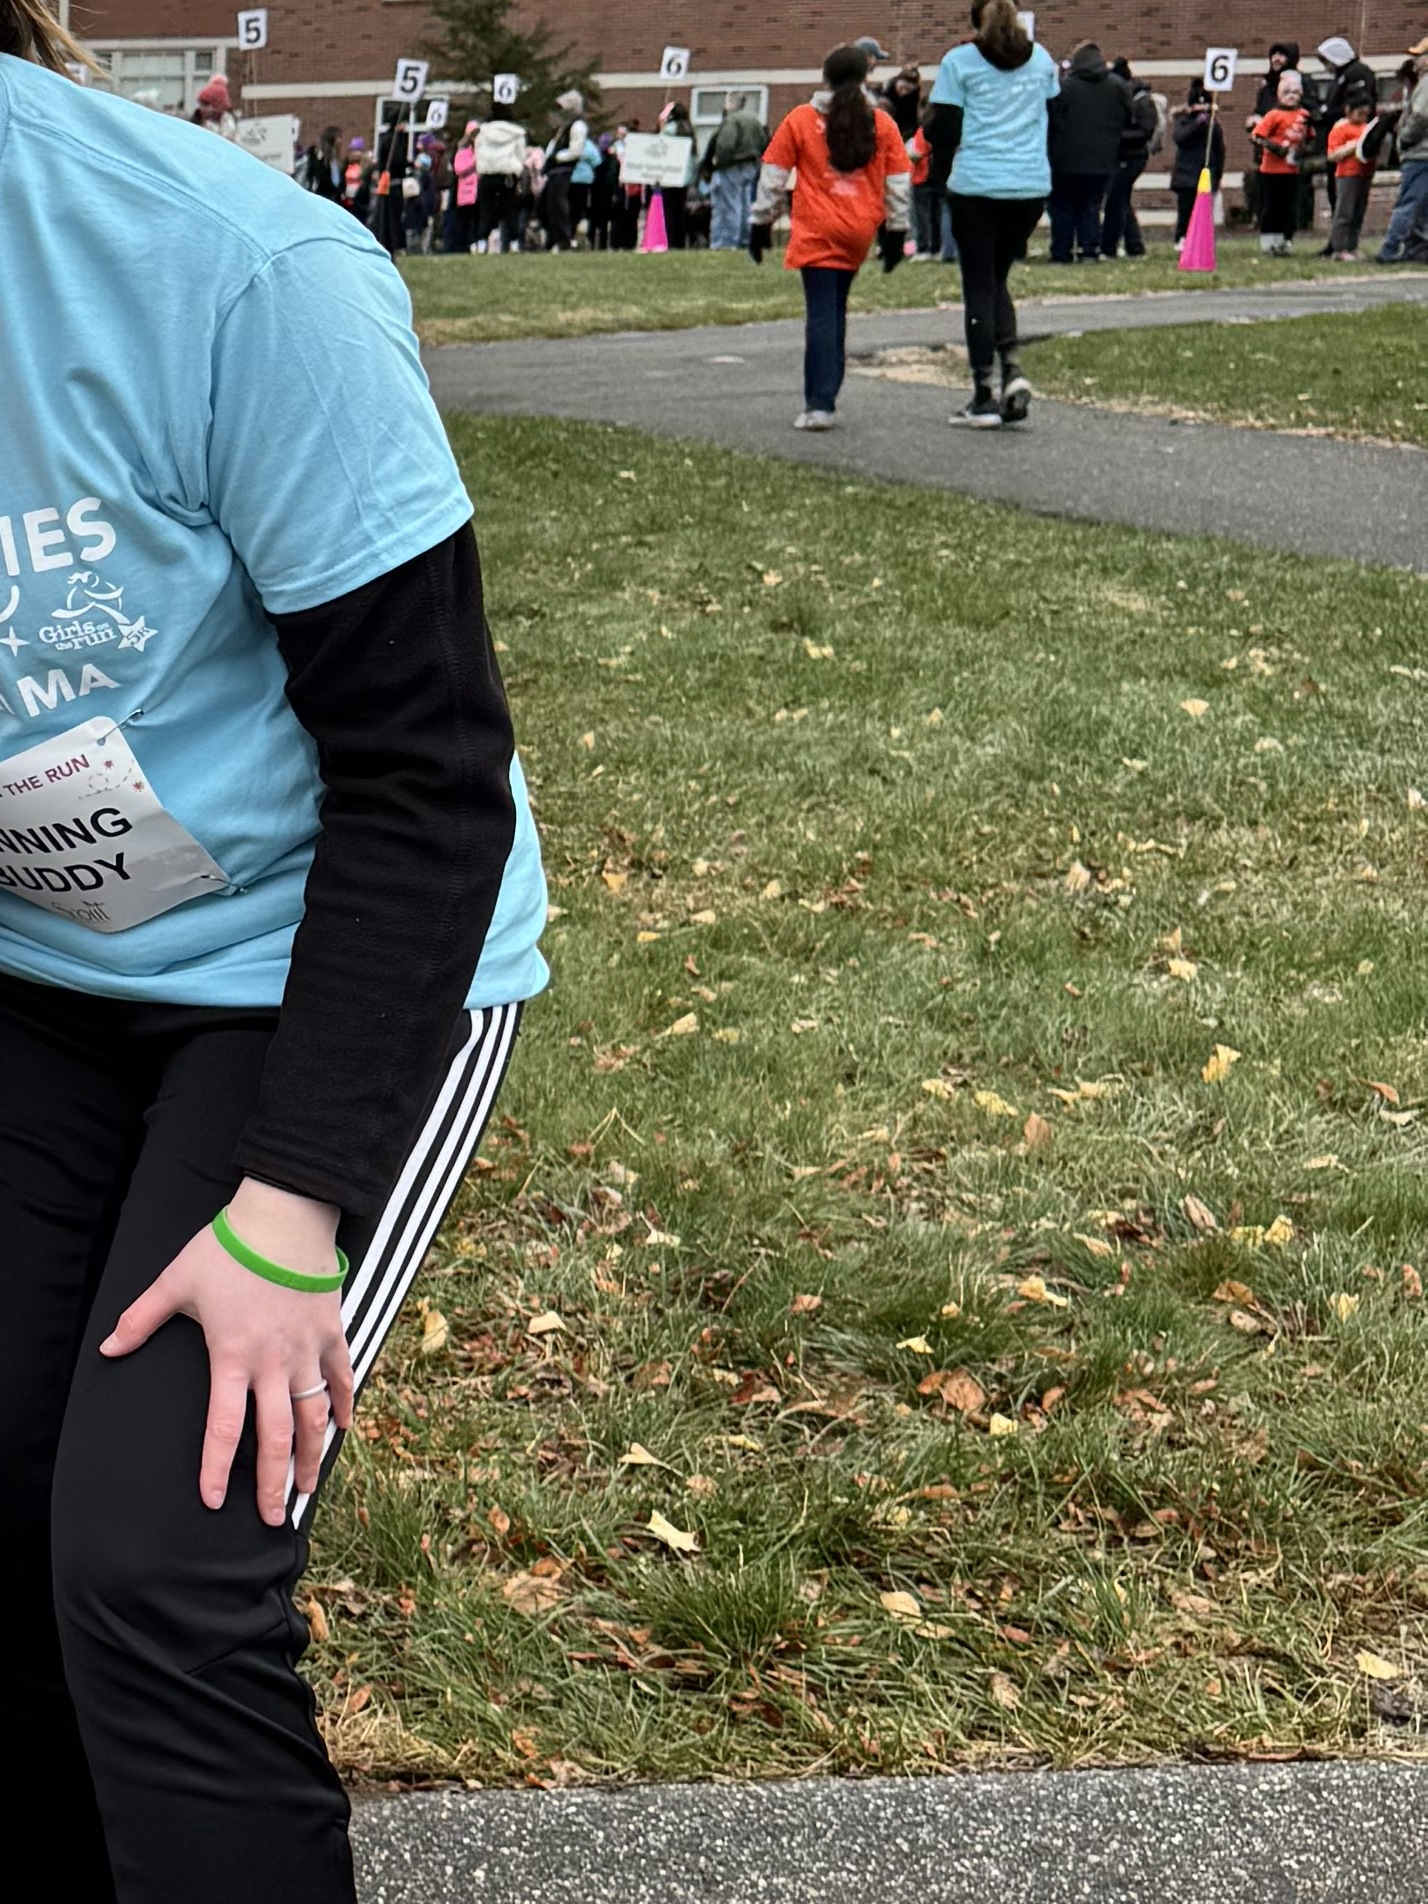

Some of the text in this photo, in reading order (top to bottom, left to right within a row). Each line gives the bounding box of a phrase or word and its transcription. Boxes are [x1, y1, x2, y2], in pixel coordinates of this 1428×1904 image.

[245, 17, 261, 44] 5
[666, 53, 682, 76] 6
[1210, 55, 1229, 82] 6
[400, 66, 420, 93] 5
[499, 79, 512, 97] 6
[38, 620, 96, 644] Girls
[72, 627, 118, 650] run
[16, 663, 122, 717] MA
[2, 775, 45, 796] THE
[44, 754, 91, 784] RUN
